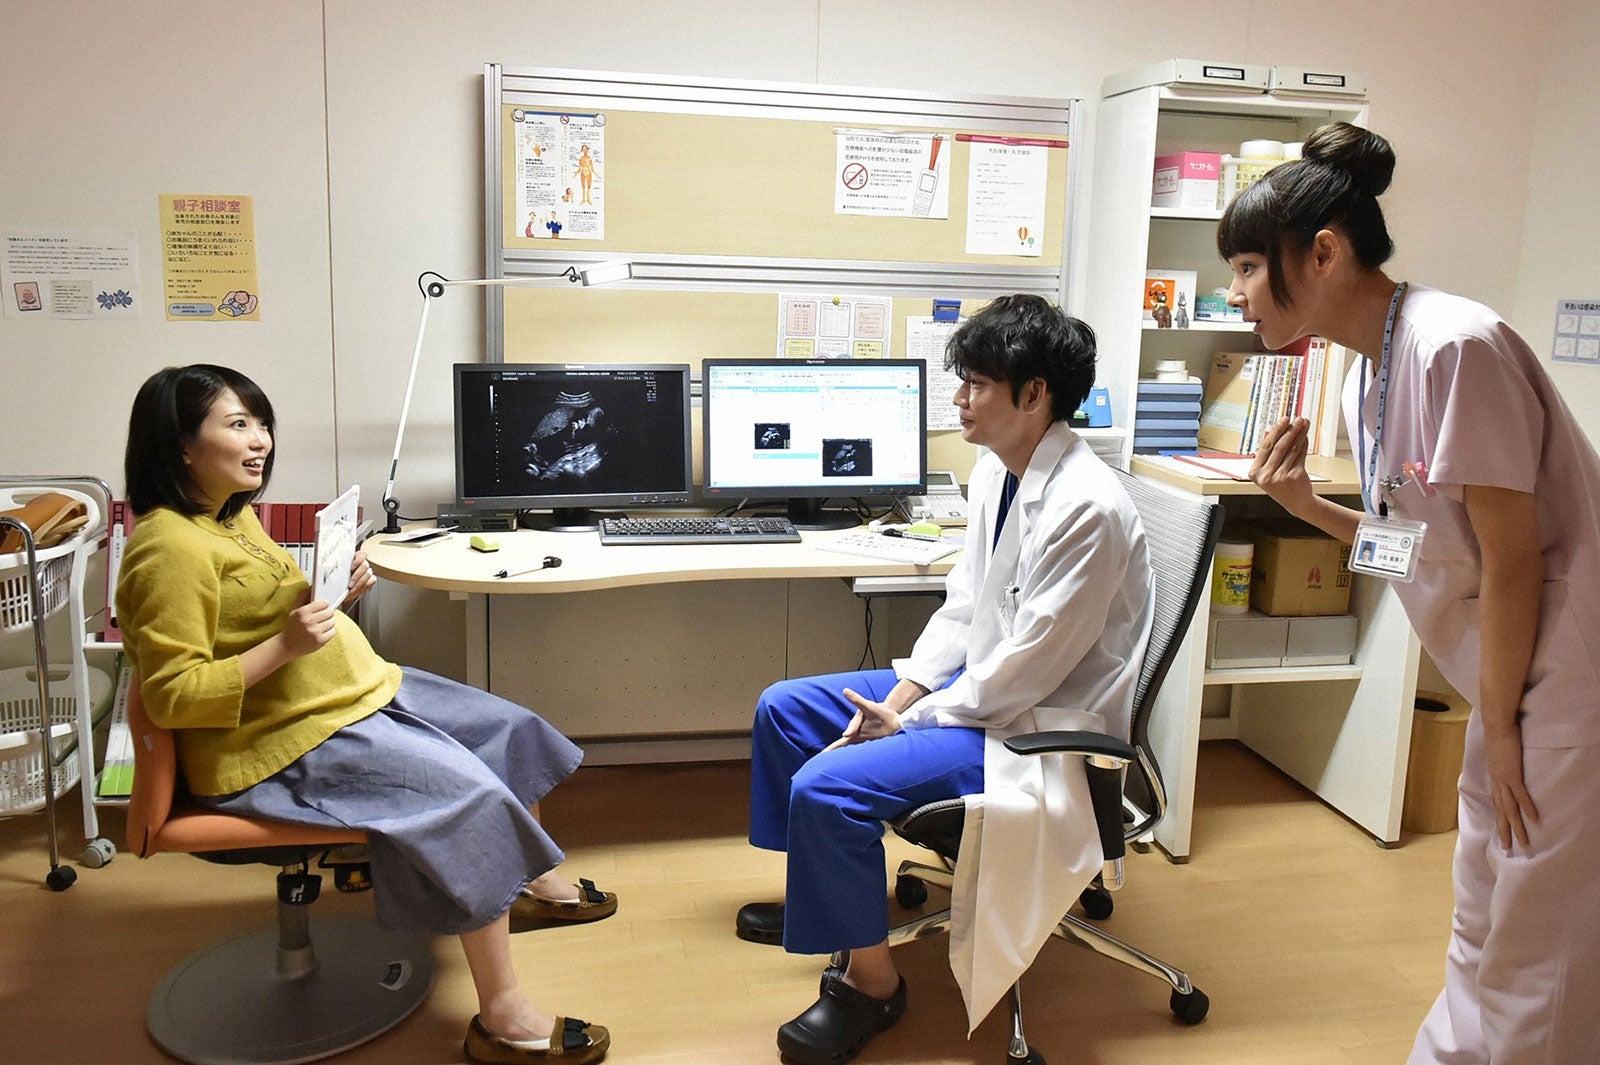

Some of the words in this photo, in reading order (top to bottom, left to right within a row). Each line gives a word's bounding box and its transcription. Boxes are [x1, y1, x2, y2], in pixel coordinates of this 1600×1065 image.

[172, 199, 241, 213] 親子相談室
